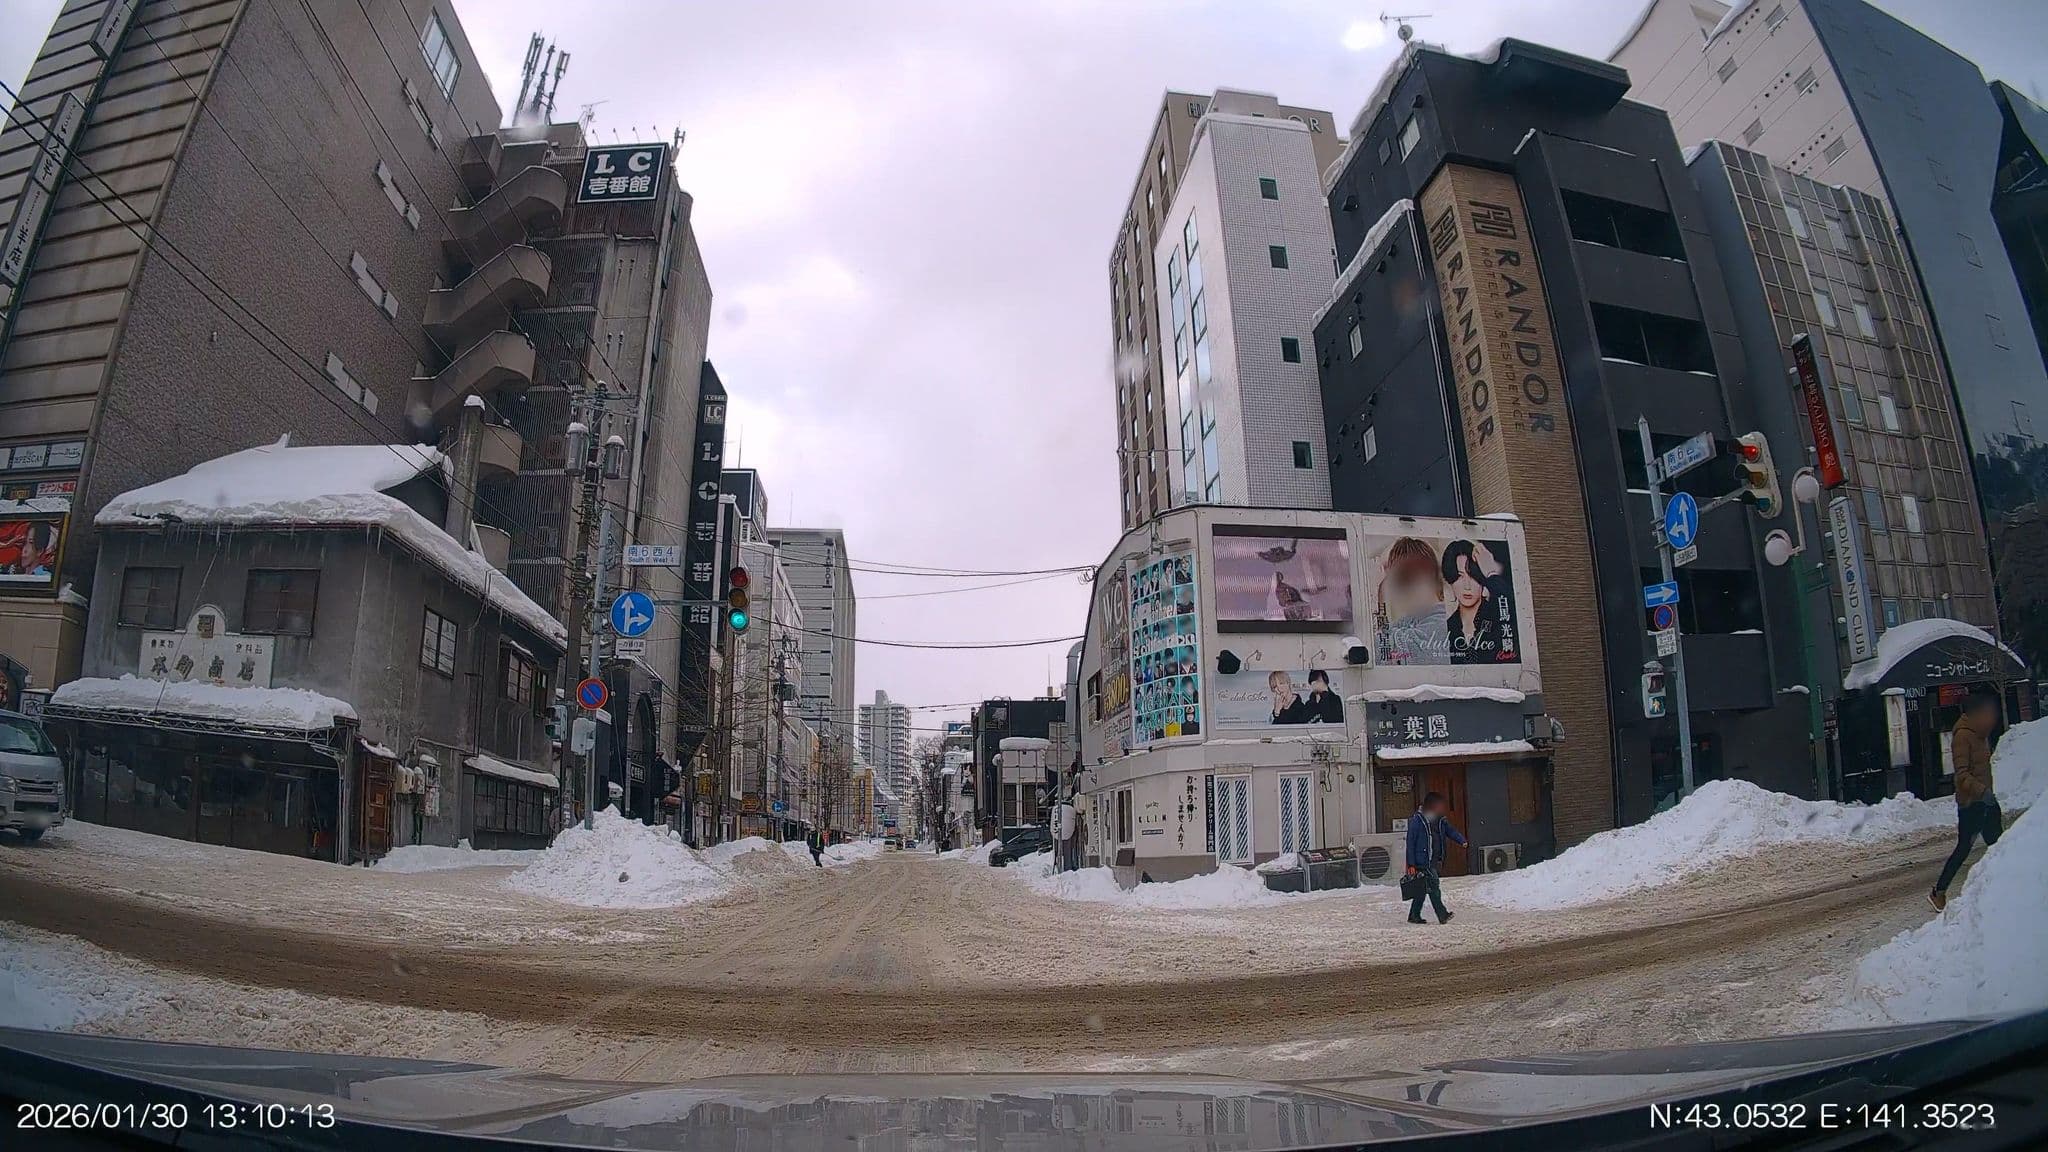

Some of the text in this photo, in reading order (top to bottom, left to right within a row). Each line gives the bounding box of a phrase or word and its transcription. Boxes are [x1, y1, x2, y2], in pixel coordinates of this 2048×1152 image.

[589, 175, 651, 195] 壱番館
[1447, 252, 1494, 446] RANDOR
[1480, 246, 1500, 299] HOTEL
[1498, 330, 1525, 431] RESIDENCE
[1496, 249, 1555, 433] RANDOR
[1838, 528, 1859, 609] DIAMOND
[1852, 614, 1866, 655] CLUB
[1420, 629, 1495, 650] club Ace
[1926, 660, 1990, 677] ニューシャトービル
[1403, 715, 1449, 740] 葉隠
